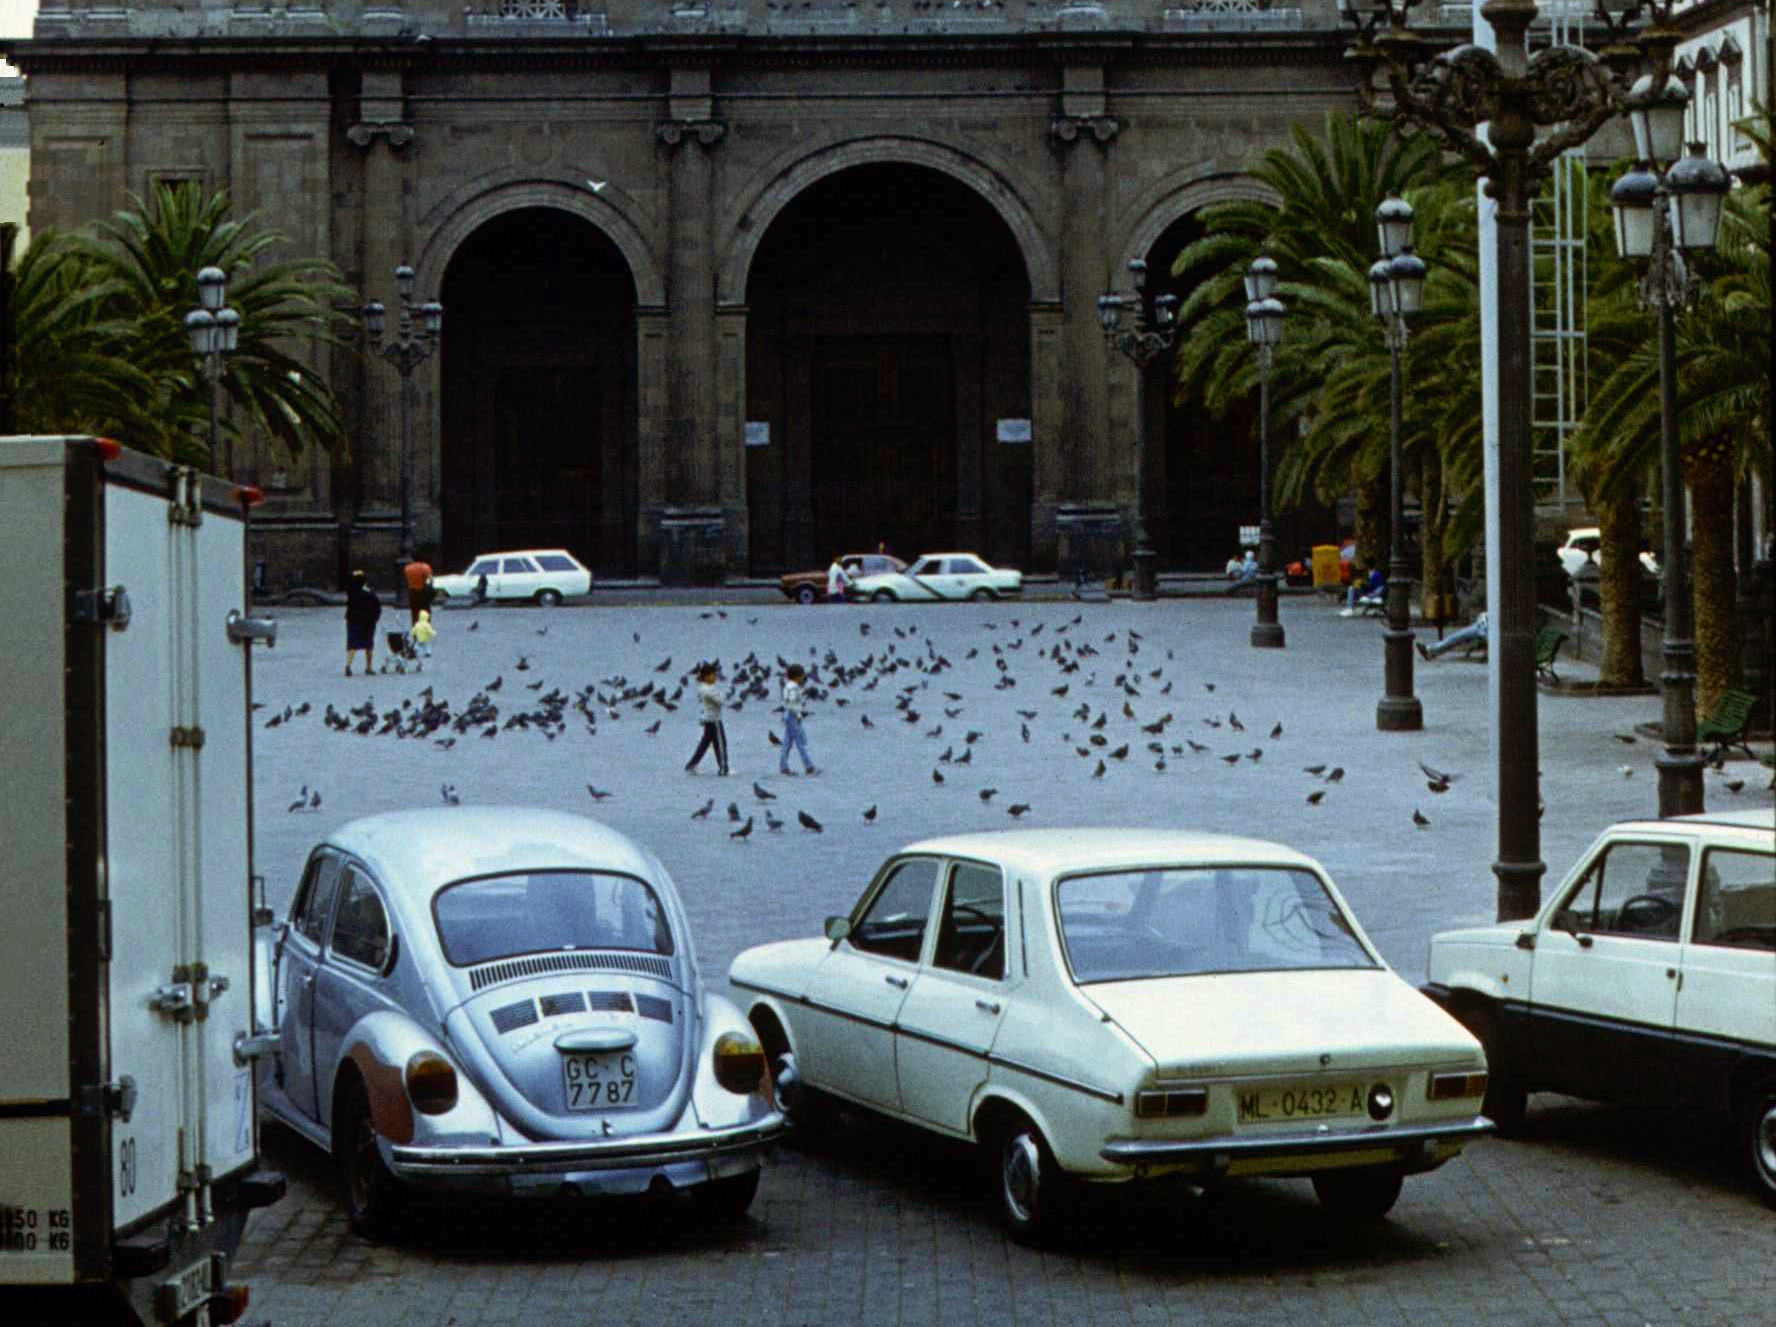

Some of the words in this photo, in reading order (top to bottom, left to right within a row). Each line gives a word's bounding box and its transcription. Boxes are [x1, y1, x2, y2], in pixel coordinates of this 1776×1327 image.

[621, 1055, 634, 1077] C
[569, 1080, 634, 1106] 7787
[120, 1137, 136, 1197] 80
[49, 1210, 69, 1227] KG
[49, 1232, 69, 1250] KG
